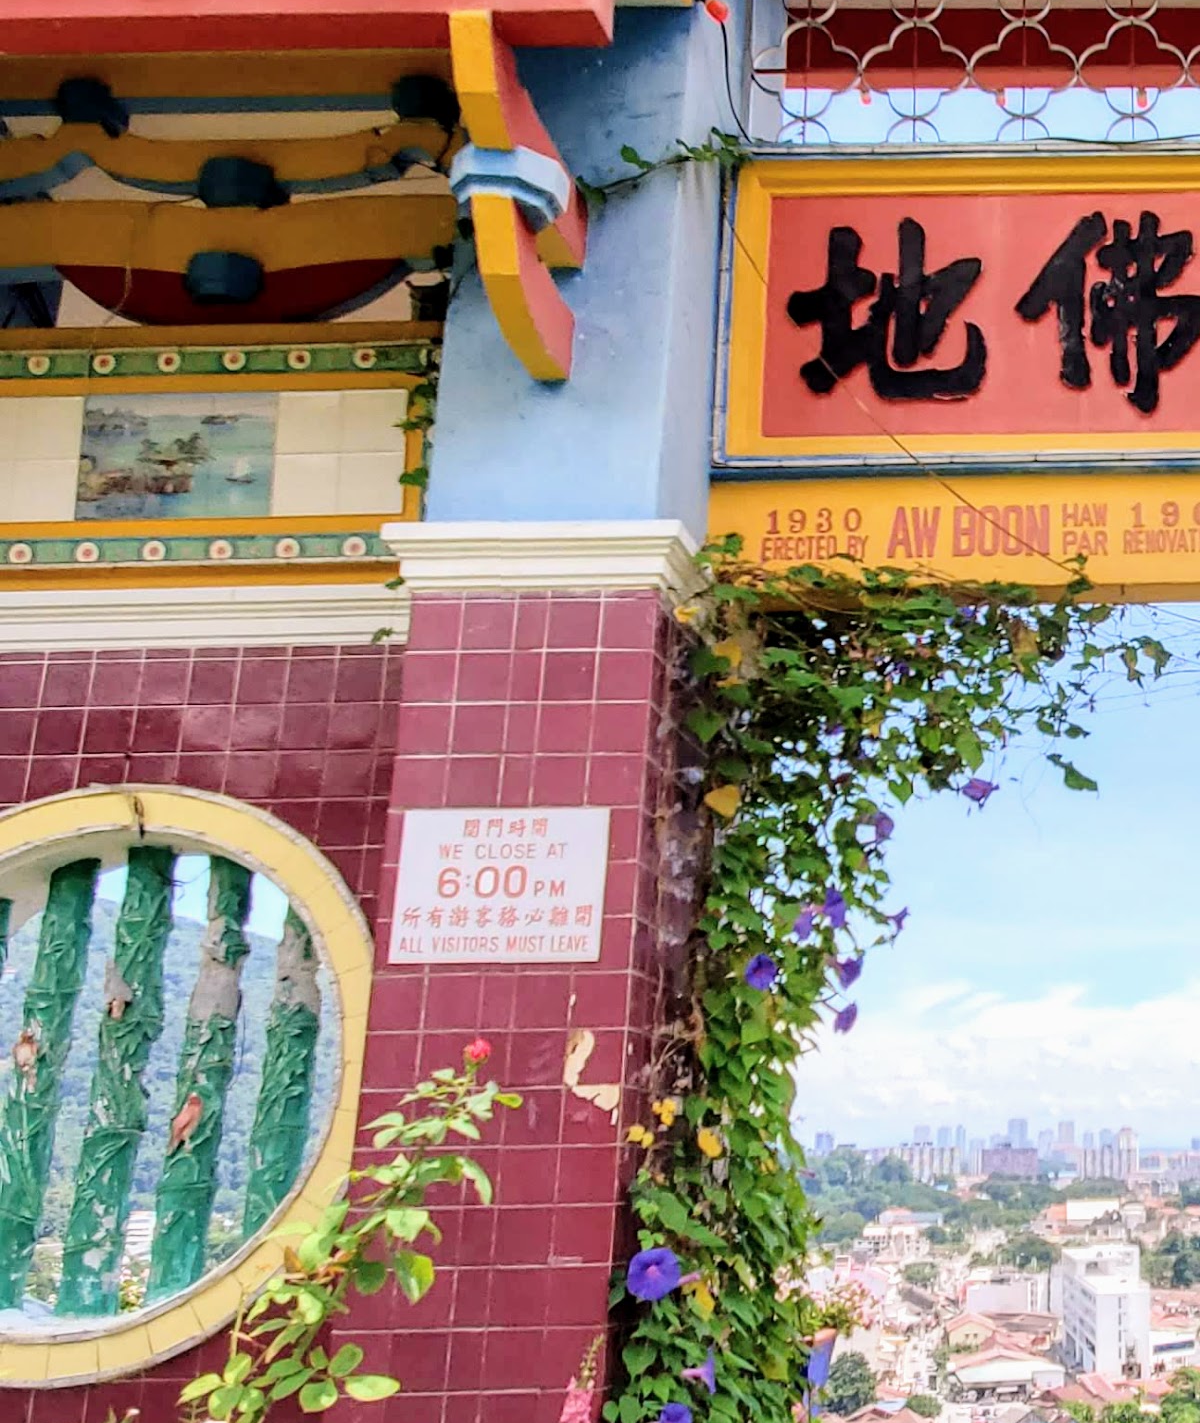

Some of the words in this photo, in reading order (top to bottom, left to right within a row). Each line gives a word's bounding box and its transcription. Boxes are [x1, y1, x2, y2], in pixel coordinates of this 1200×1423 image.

[766, 508, 862, 535] 1930
[1061, 503, 1108, 528] HAW
[886, 506, 941, 559] AW
[952, 504, 1050, 557] BOON
[1061, 530, 1109, 556] PAR
[761, 535, 837, 563] ERECTED
[847, 535, 869, 562] BY
[439, 844, 464, 859] WE
[474, 843, 537, 859] CLOSE
[547, 843, 568, 859] AT
[437, 865, 528, 899] 6:00
[399, 936, 423, 954] ALL
[432, 935, 499, 954] VISITORS
[506, 935, 544, 953] MUST
[550, 934, 589, 953] LEAVE
